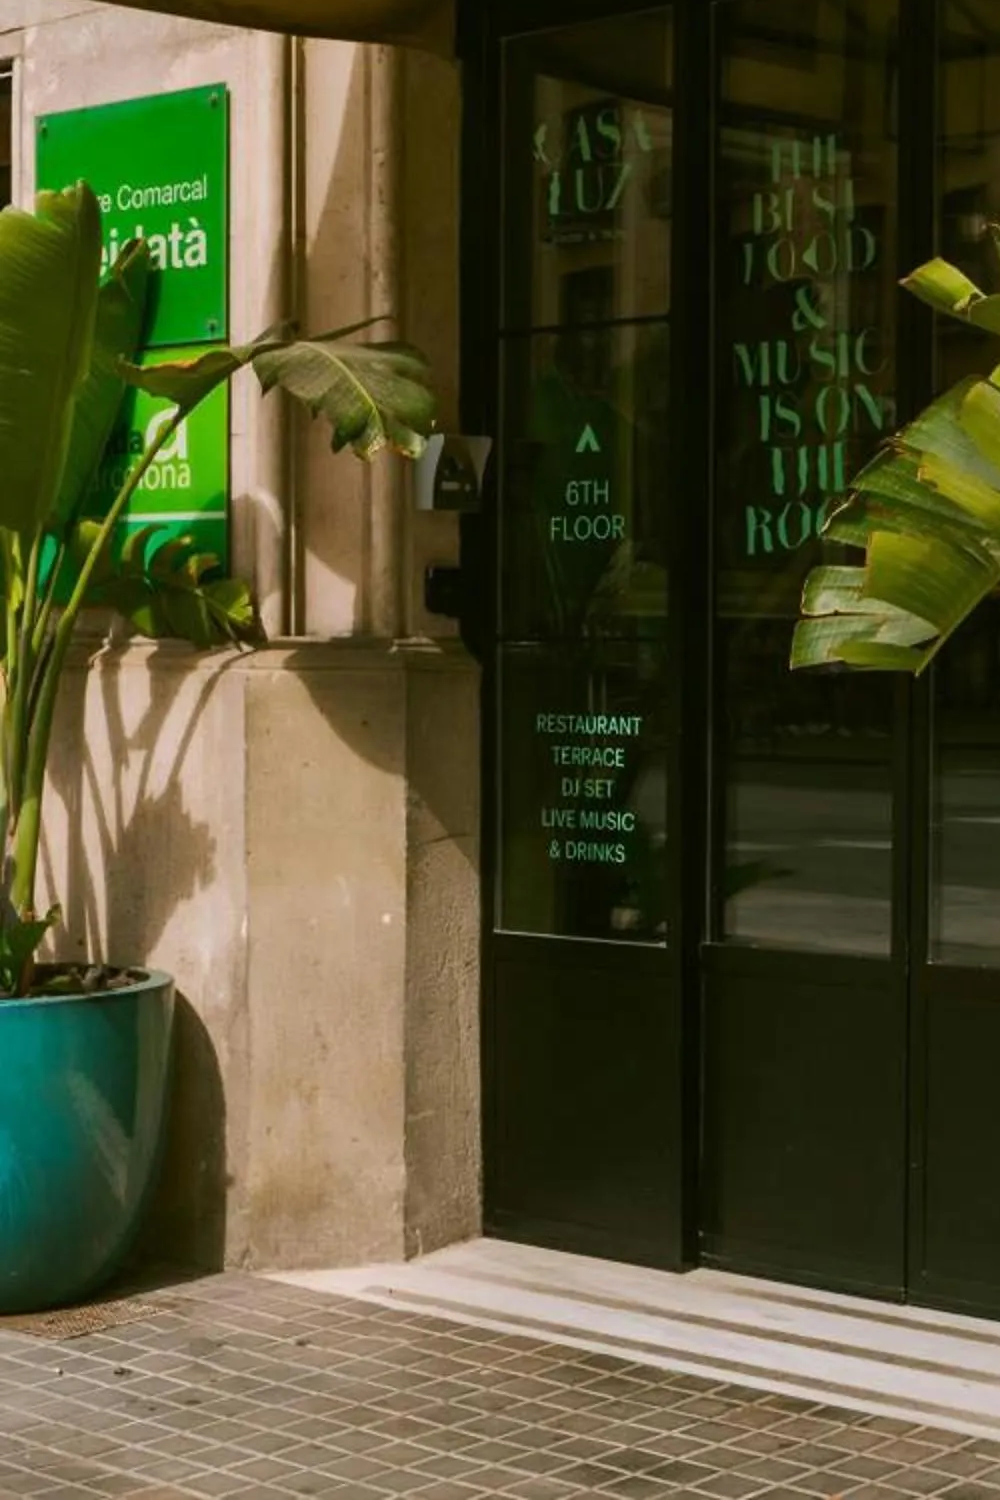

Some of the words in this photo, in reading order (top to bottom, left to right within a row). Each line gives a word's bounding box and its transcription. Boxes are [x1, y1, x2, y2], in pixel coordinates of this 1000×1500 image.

[117, 173, 208, 211] Comarcal
[792, 285, 827, 332] &
[733, 326, 890, 387] MUSIC
[759, 394, 801, 442] IS
[815, 384, 886, 436] ON
[565, 479, 609, 507] 6TH
[550, 514, 625, 542] FLOOR
[536, 713, 642, 736] RESTAURANT
[551, 745, 626, 768] TERRACE
[561, 776, 580, 798] DJ
[583, 778, 615, 799] SET
[541, 807, 576, 829] LIVE
[579, 809, 636, 832] MUSIC
[549, 839, 560, 859] &
[565, 840, 626, 864] DRINKS
